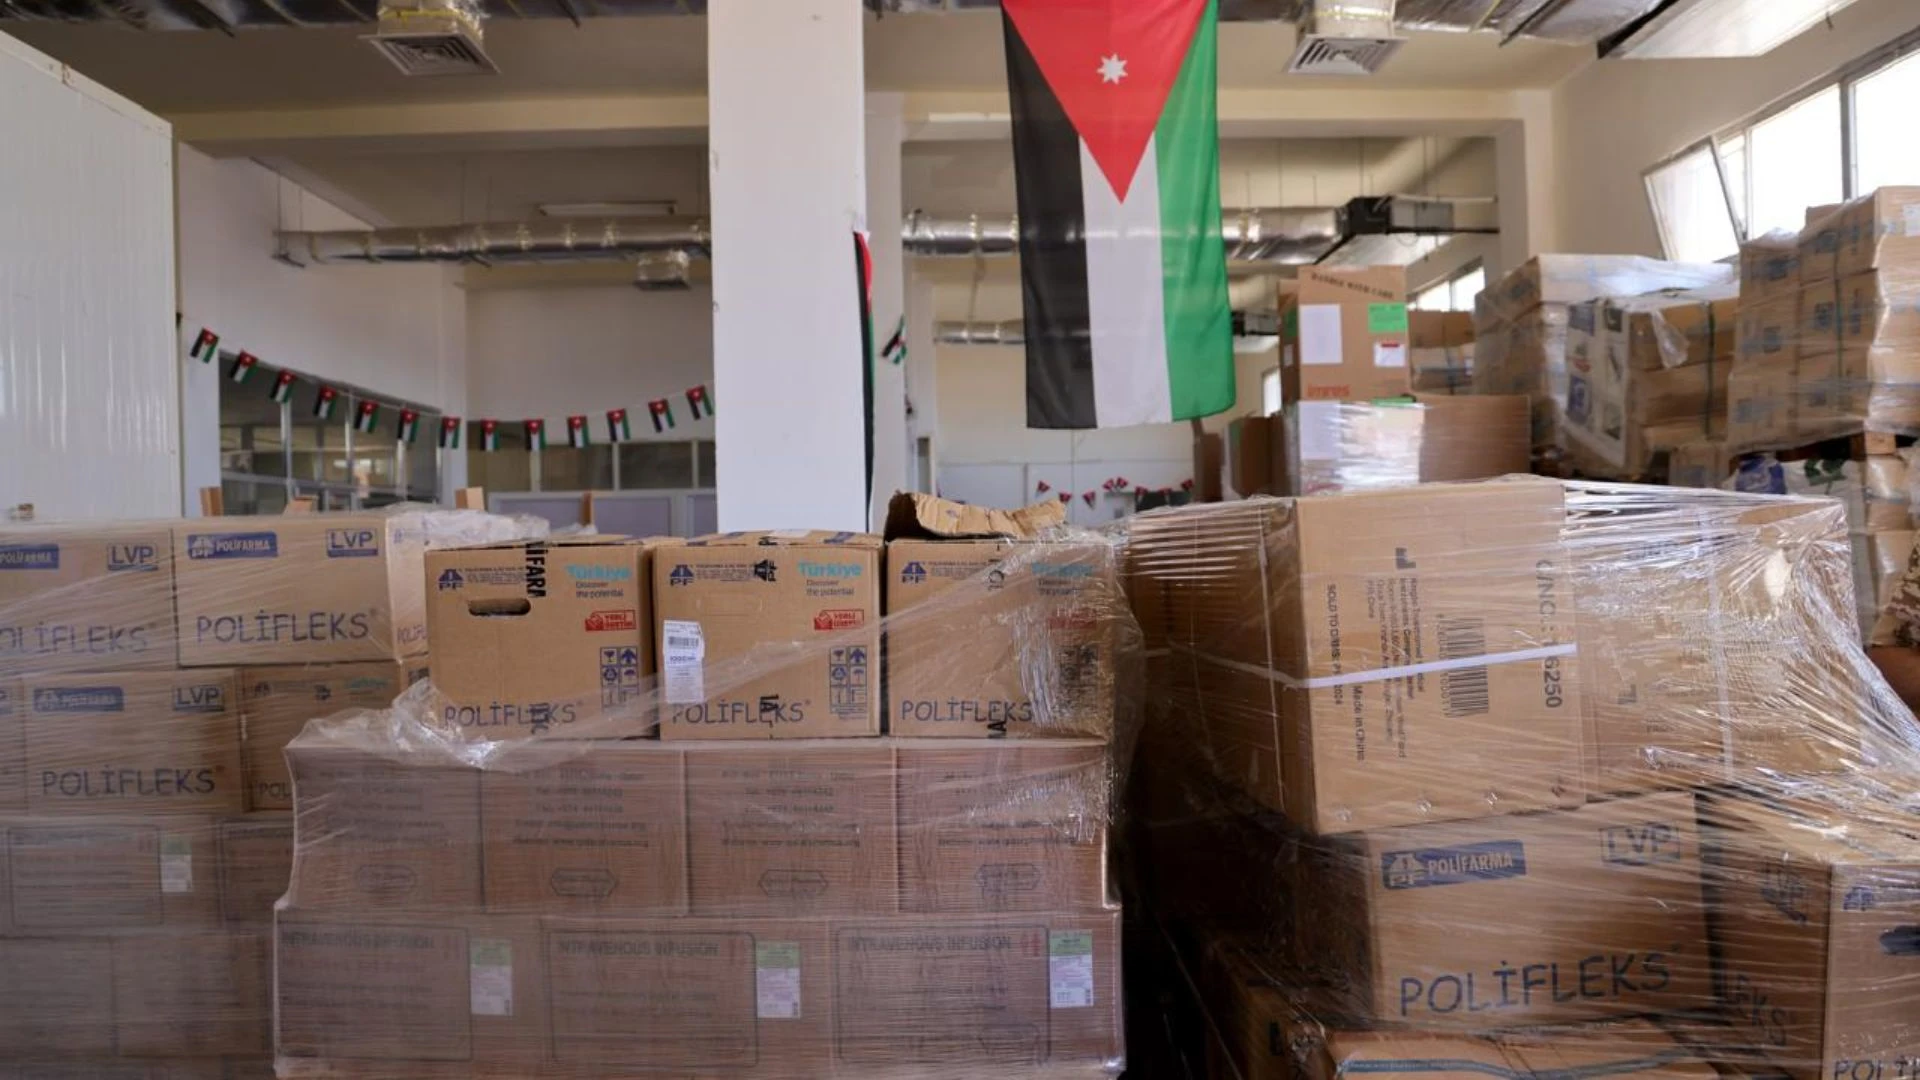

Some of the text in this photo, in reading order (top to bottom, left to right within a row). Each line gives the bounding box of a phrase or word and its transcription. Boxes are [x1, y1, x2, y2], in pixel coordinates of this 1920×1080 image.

[331, 531, 373, 548] LVP
[111, 546, 153, 563] LVP
[566, 563, 631, 580] Türkiye
[799, 561, 862, 578] Türkiye
[196, 609, 369, 643] POLİFLEKS
[177, 688, 220, 705] LVP
[1352, 686, 1363, 714] Made
[1355, 729, 1365, 760] China
[42, 764, 215, 796] POLİFLEKS
[1428, 851, 1513, 875] POLİFARMA
[1400, 952, 1671, 1017] POLİFLEKS
